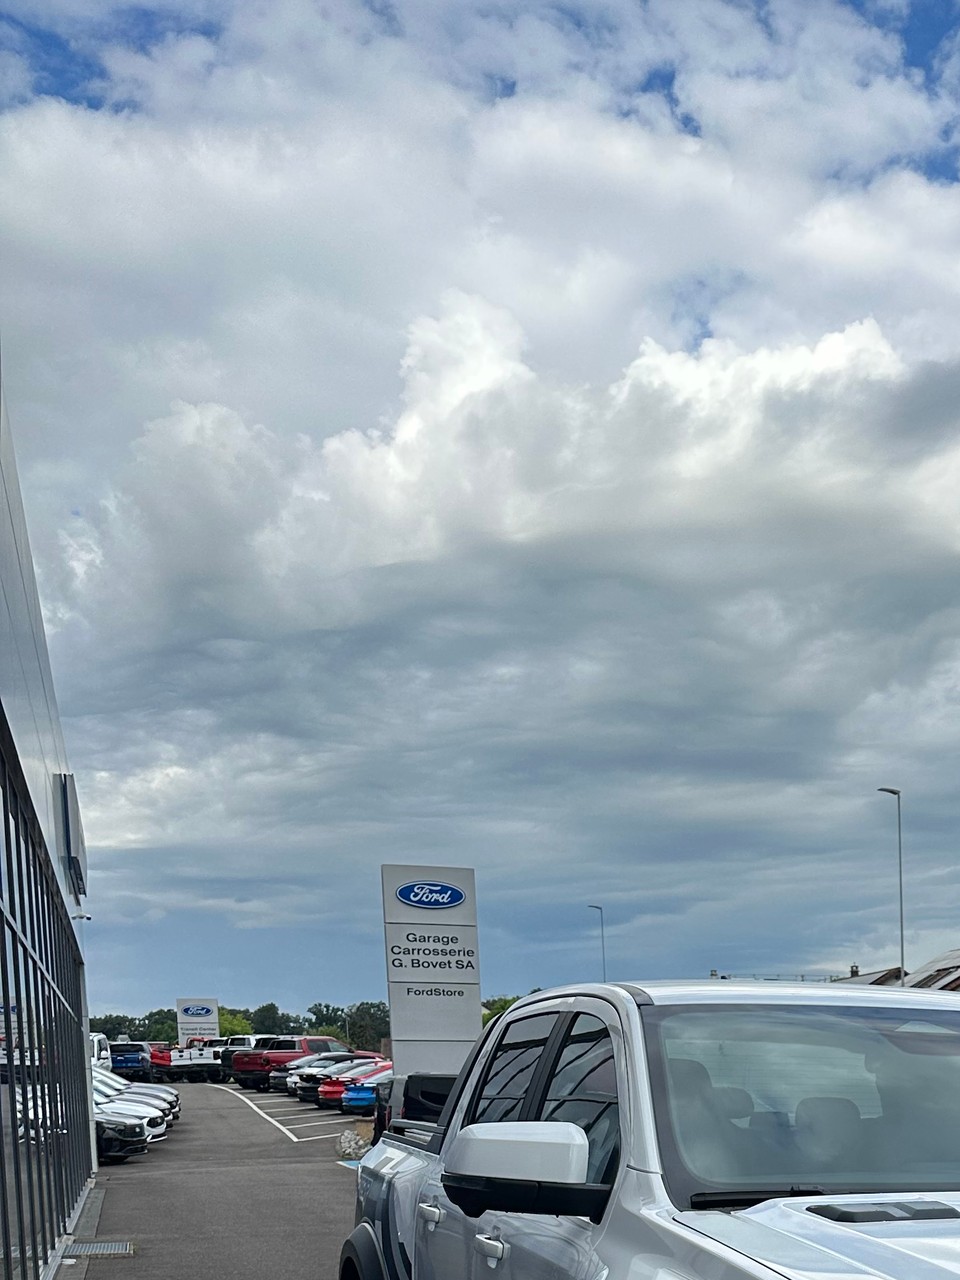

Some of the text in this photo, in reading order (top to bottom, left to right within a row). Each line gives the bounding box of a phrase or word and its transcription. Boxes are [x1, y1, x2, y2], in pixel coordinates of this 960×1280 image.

[410, 884, 452, 903] Ford
[405, 932, 459, 946] Garage
[390, 945, 475, 957] Carrosserie
[391, 958, 475, 970] G. Bovet SA
[406, 987, 464, 997] FordStore
